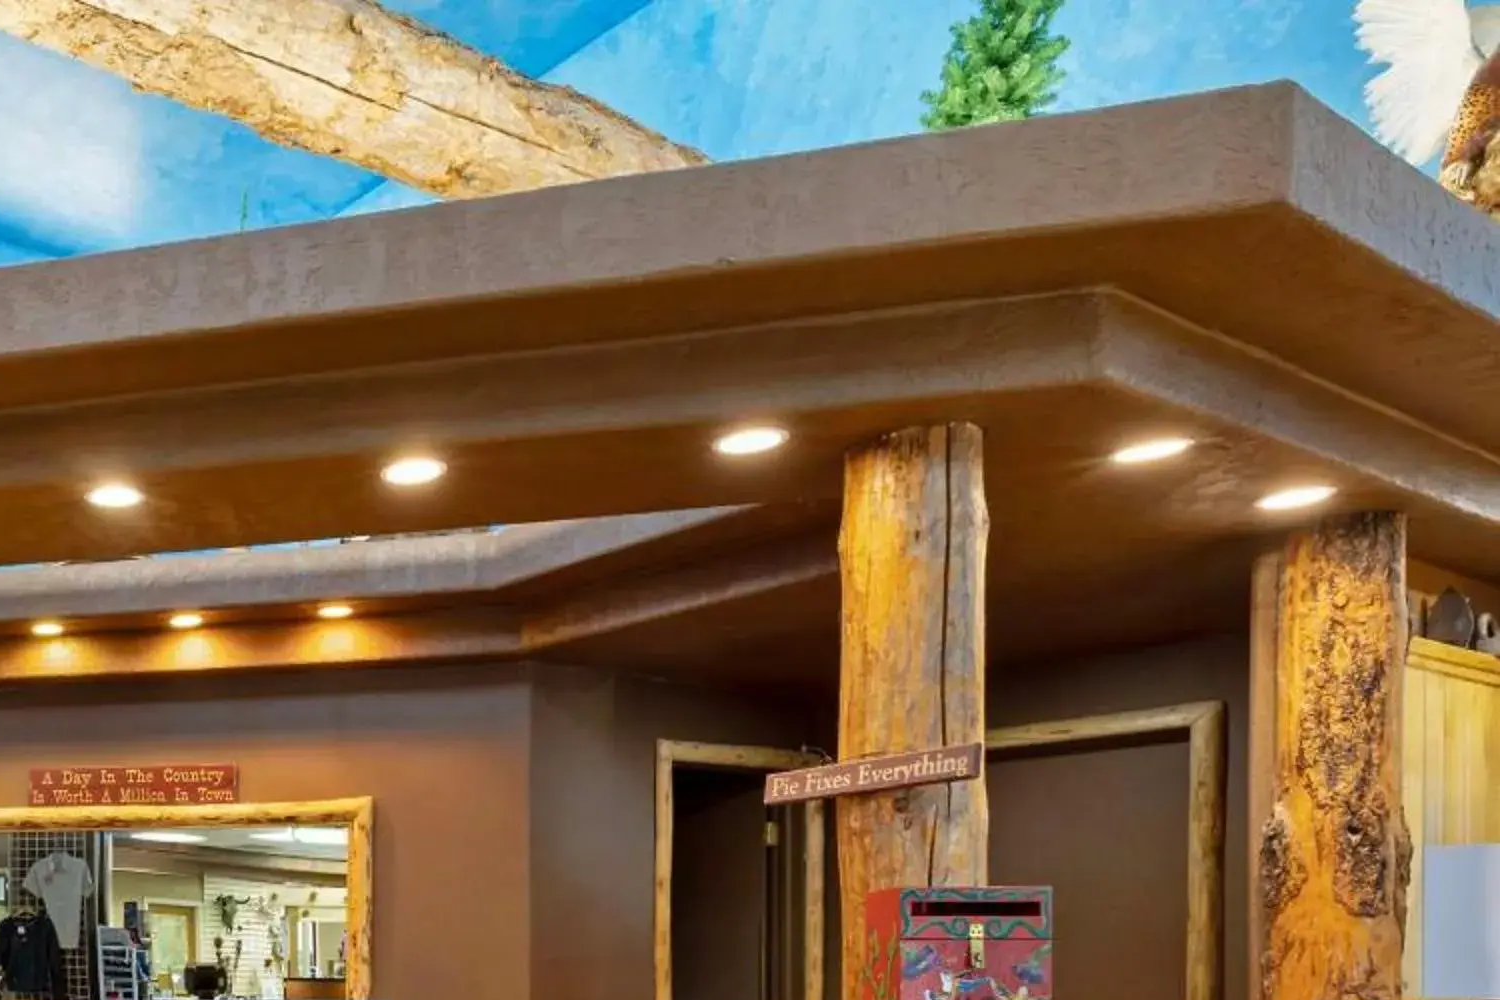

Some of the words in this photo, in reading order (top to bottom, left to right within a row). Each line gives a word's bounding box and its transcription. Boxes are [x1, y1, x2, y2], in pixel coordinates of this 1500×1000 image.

[41, 771, 54, 785] A
[62, 769, 92, 789] Day
[100, 769, 117, 785] In
[126, 769, 155, 784] The
[163, 767, 225, 787] Country
[771, 776, 800, 797] Pie
[804, 771, 851, 793] Fixes
[857, 753, 969, 786] Everything
[52, 788, 93, 804] Worth
[101, 787, 112, 803] A
[175, 786, 189, 801] In
[197, 786, 234, 801] Town
